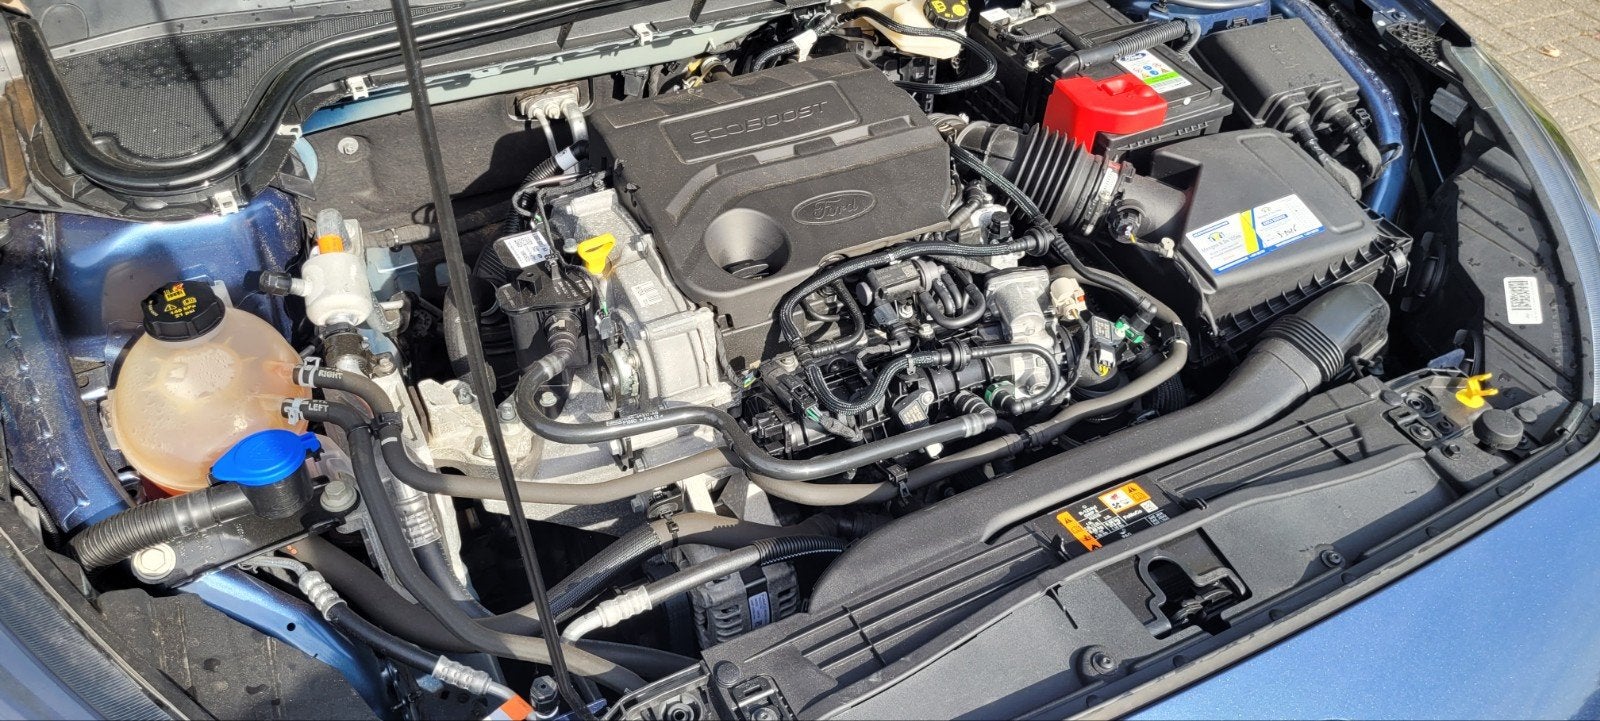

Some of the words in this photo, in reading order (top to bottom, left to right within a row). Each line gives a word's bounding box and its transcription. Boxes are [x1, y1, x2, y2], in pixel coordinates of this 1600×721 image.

[688, 101, 828, 144] ECOBOOST
[812, 197, 859, 220] Ford
[318, 369, 343, 380] RIGHT
[308, 403, 330, 413] LEFT
